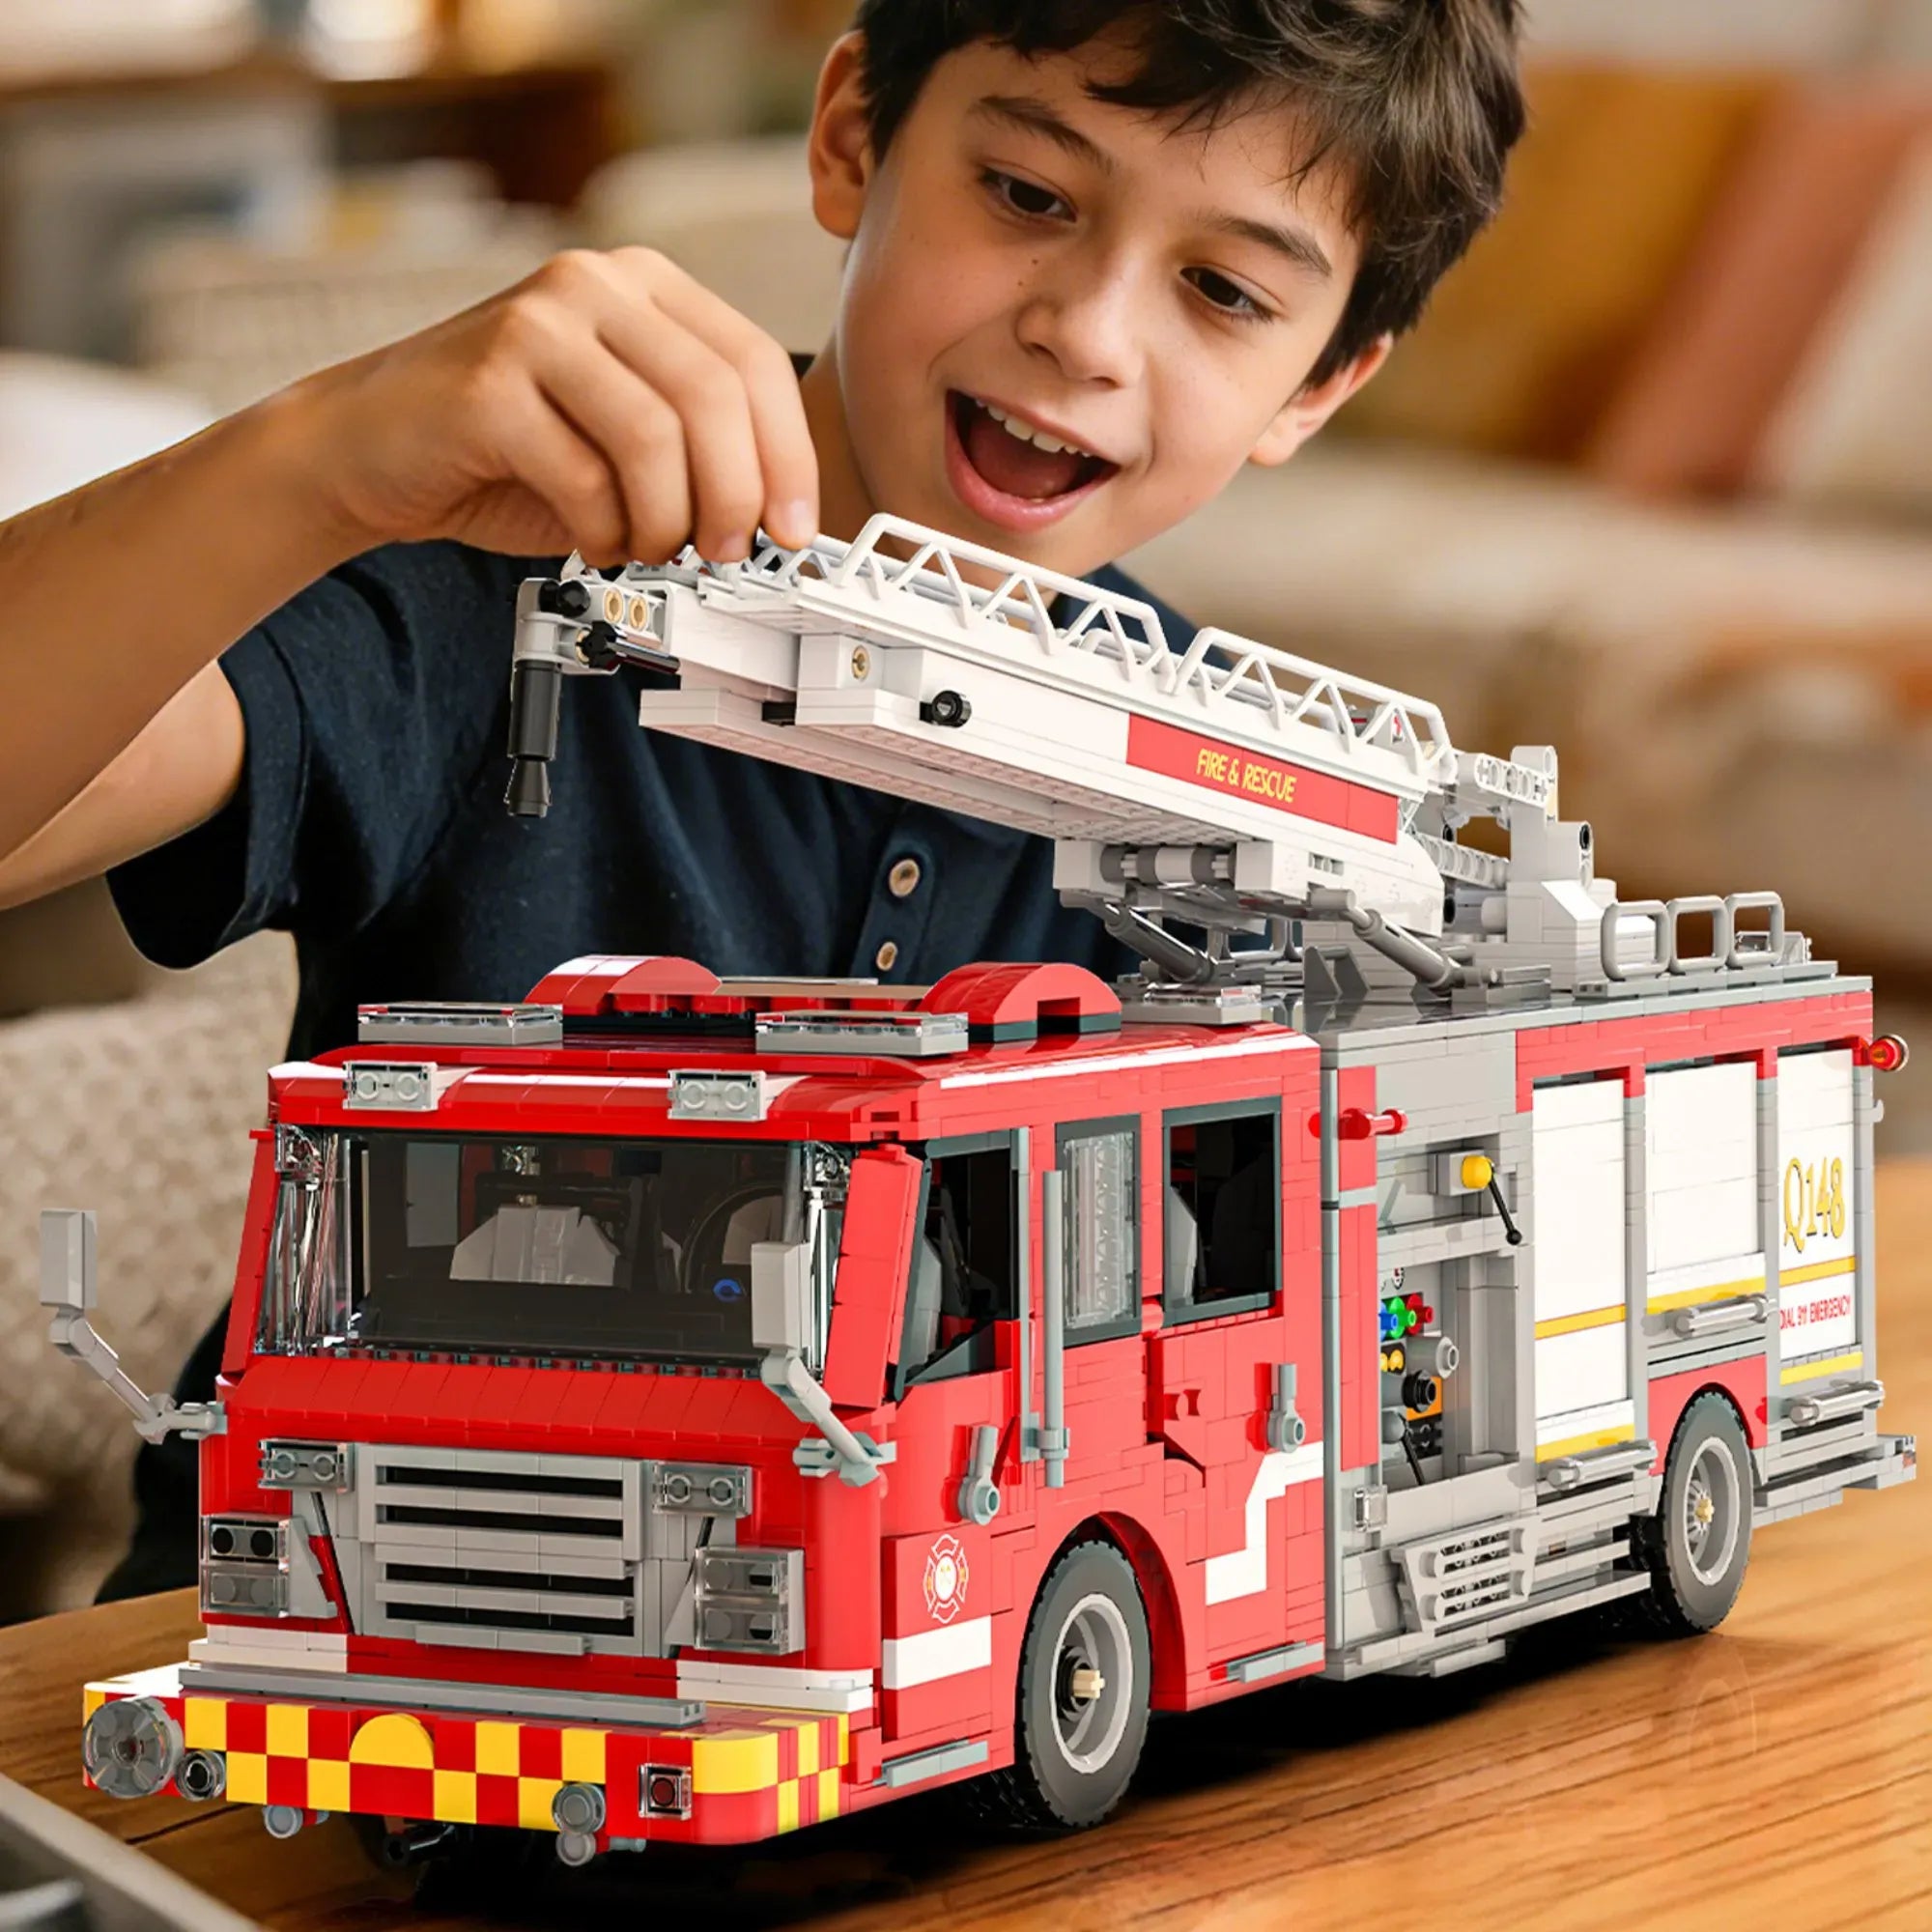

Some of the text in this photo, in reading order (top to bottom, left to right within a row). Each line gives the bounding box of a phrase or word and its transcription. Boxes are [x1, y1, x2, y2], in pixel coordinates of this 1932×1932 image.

[1196, 749, 1297, 803] FIRE & RESCUE
[1784, 1157, 1845, 1253] Q148
[1809, 1294, 1851, 1323] EMERGENCY
